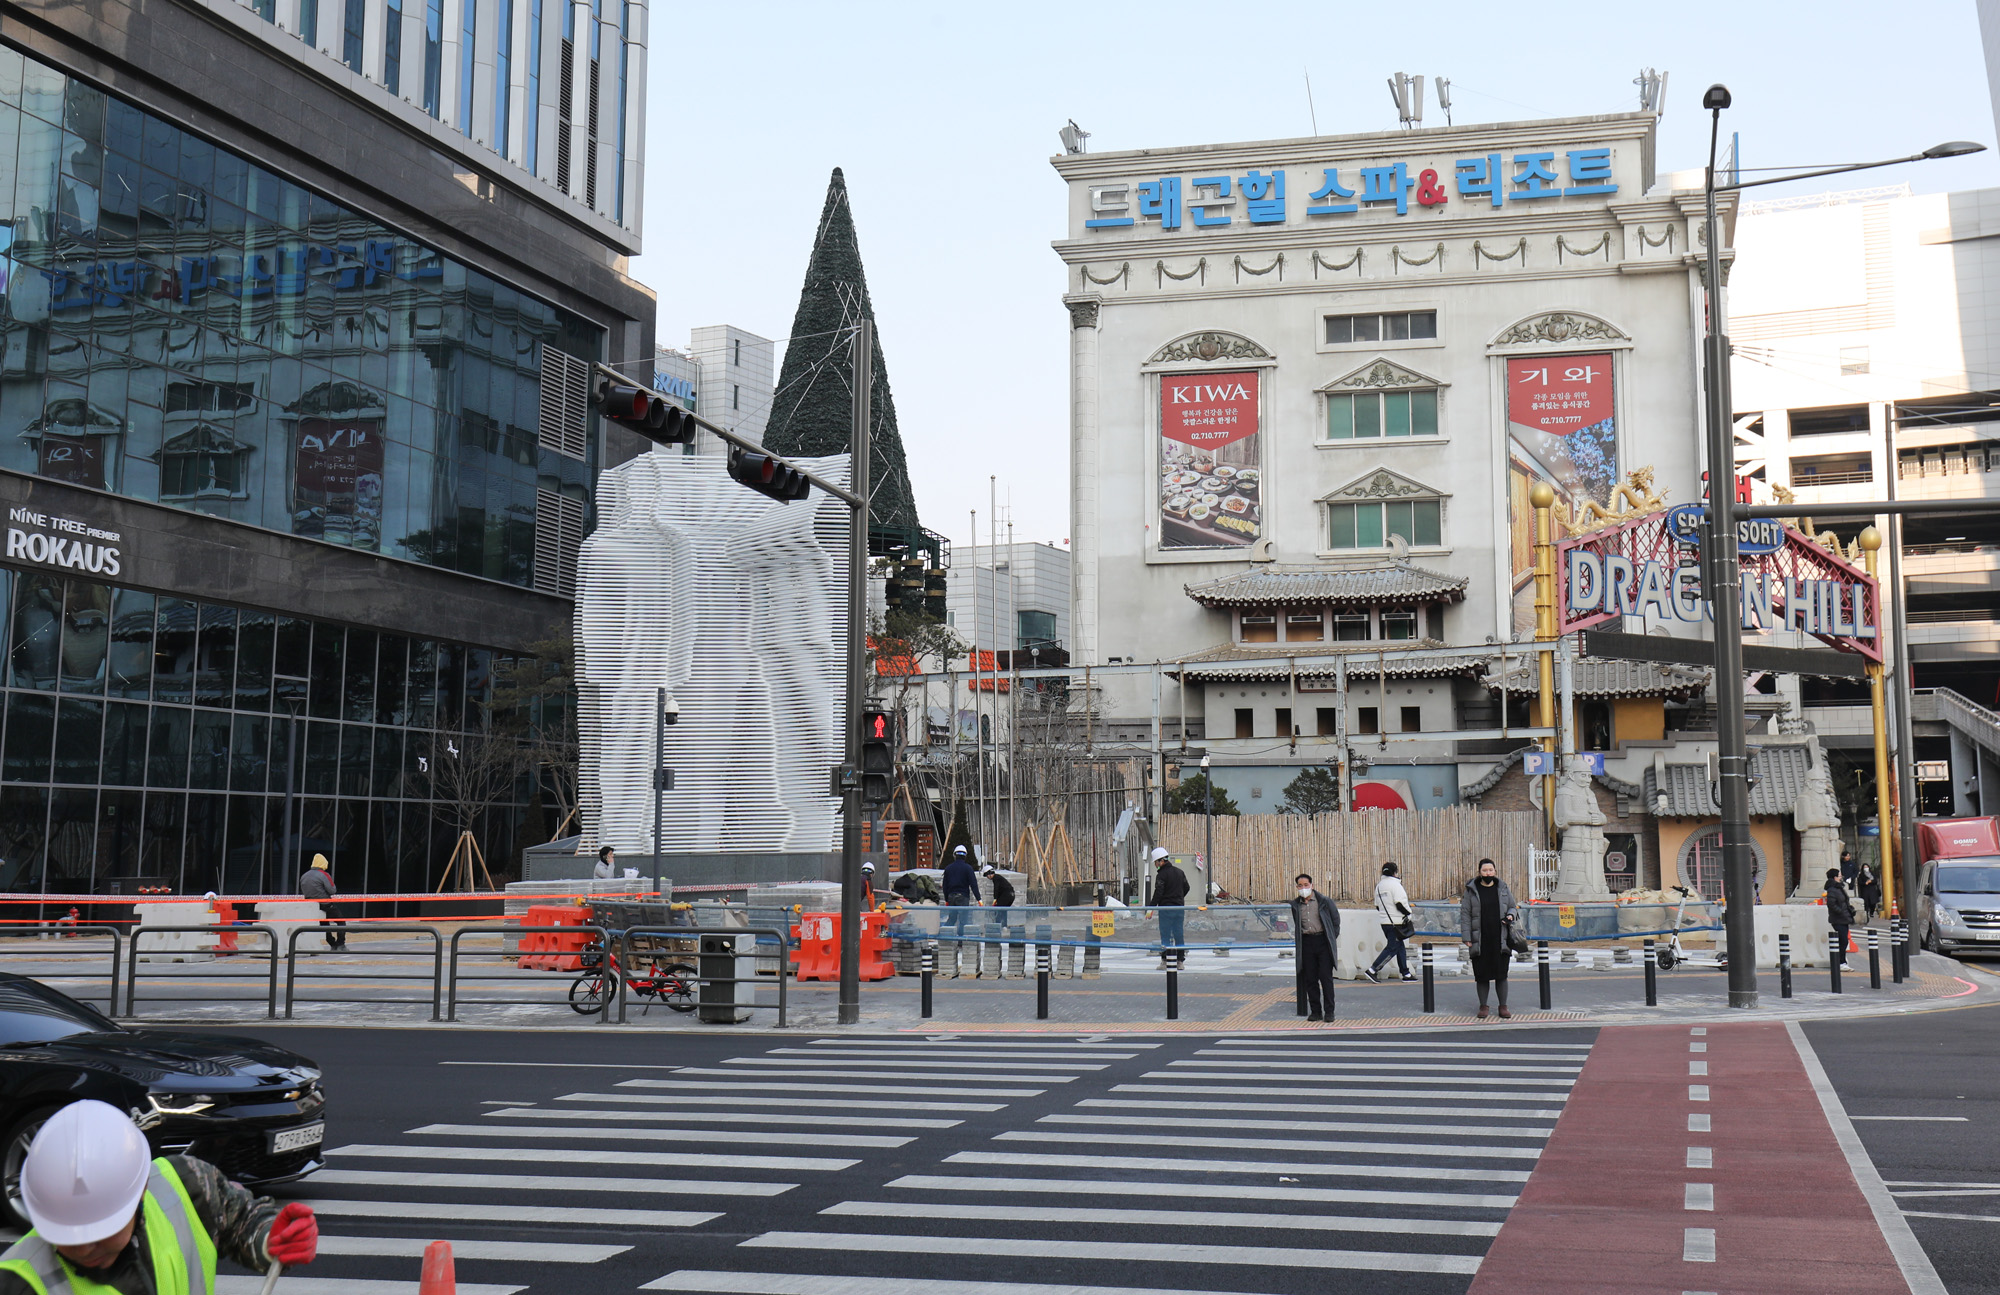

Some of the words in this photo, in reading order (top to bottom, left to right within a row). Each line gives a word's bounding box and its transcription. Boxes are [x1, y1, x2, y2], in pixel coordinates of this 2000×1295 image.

[1085, 169, 1286, 229] 드래곤힐
[1171, 383, 1252, 404] KIWA
[1203, 409, 1222, 417] 건강을
[1217, 416, 1237, 424] 한정식
[1540, 415, 1582, 424] 02.710.7777
[1191, 431, 1229, 440] 02.710.7777
[50, 516, 87, 535] TREE
[86, 527, 121, 542] PREMIER
[6, 527, 121, 576] ROKAUS
[1569, 550, 1773, 629] DRAGN
[1785, 576, 1876, 638] HILL
[1528, 755, 1542, 773] P
